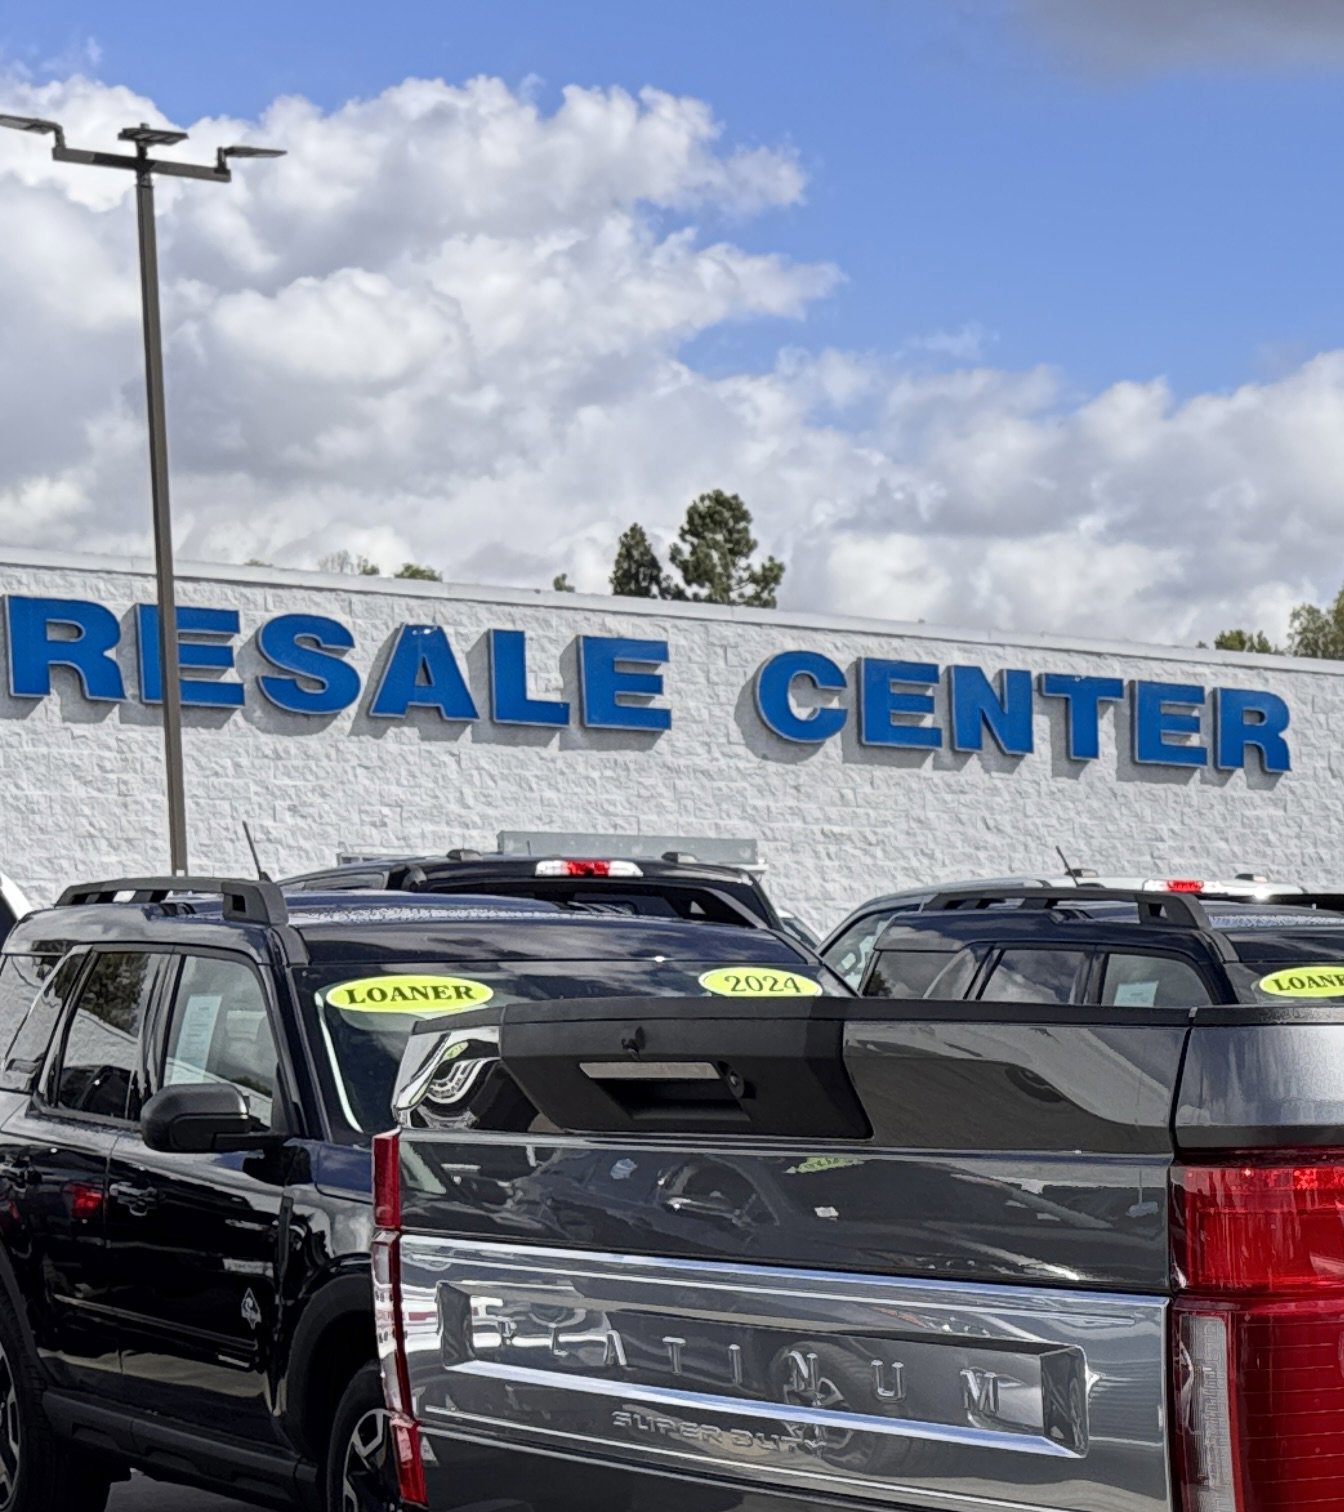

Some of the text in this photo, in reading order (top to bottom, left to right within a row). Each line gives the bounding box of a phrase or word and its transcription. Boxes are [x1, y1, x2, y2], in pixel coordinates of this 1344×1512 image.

[5, 594, 1292, 773] RESALE CENTER
[346, 981, 476, 1004] LOANER
[724, 973, 801, 994] 2024
[498, 1319, 1000, 1411] PLATINUM
[611, 1410, 827, 1453] SUPER DUTY
